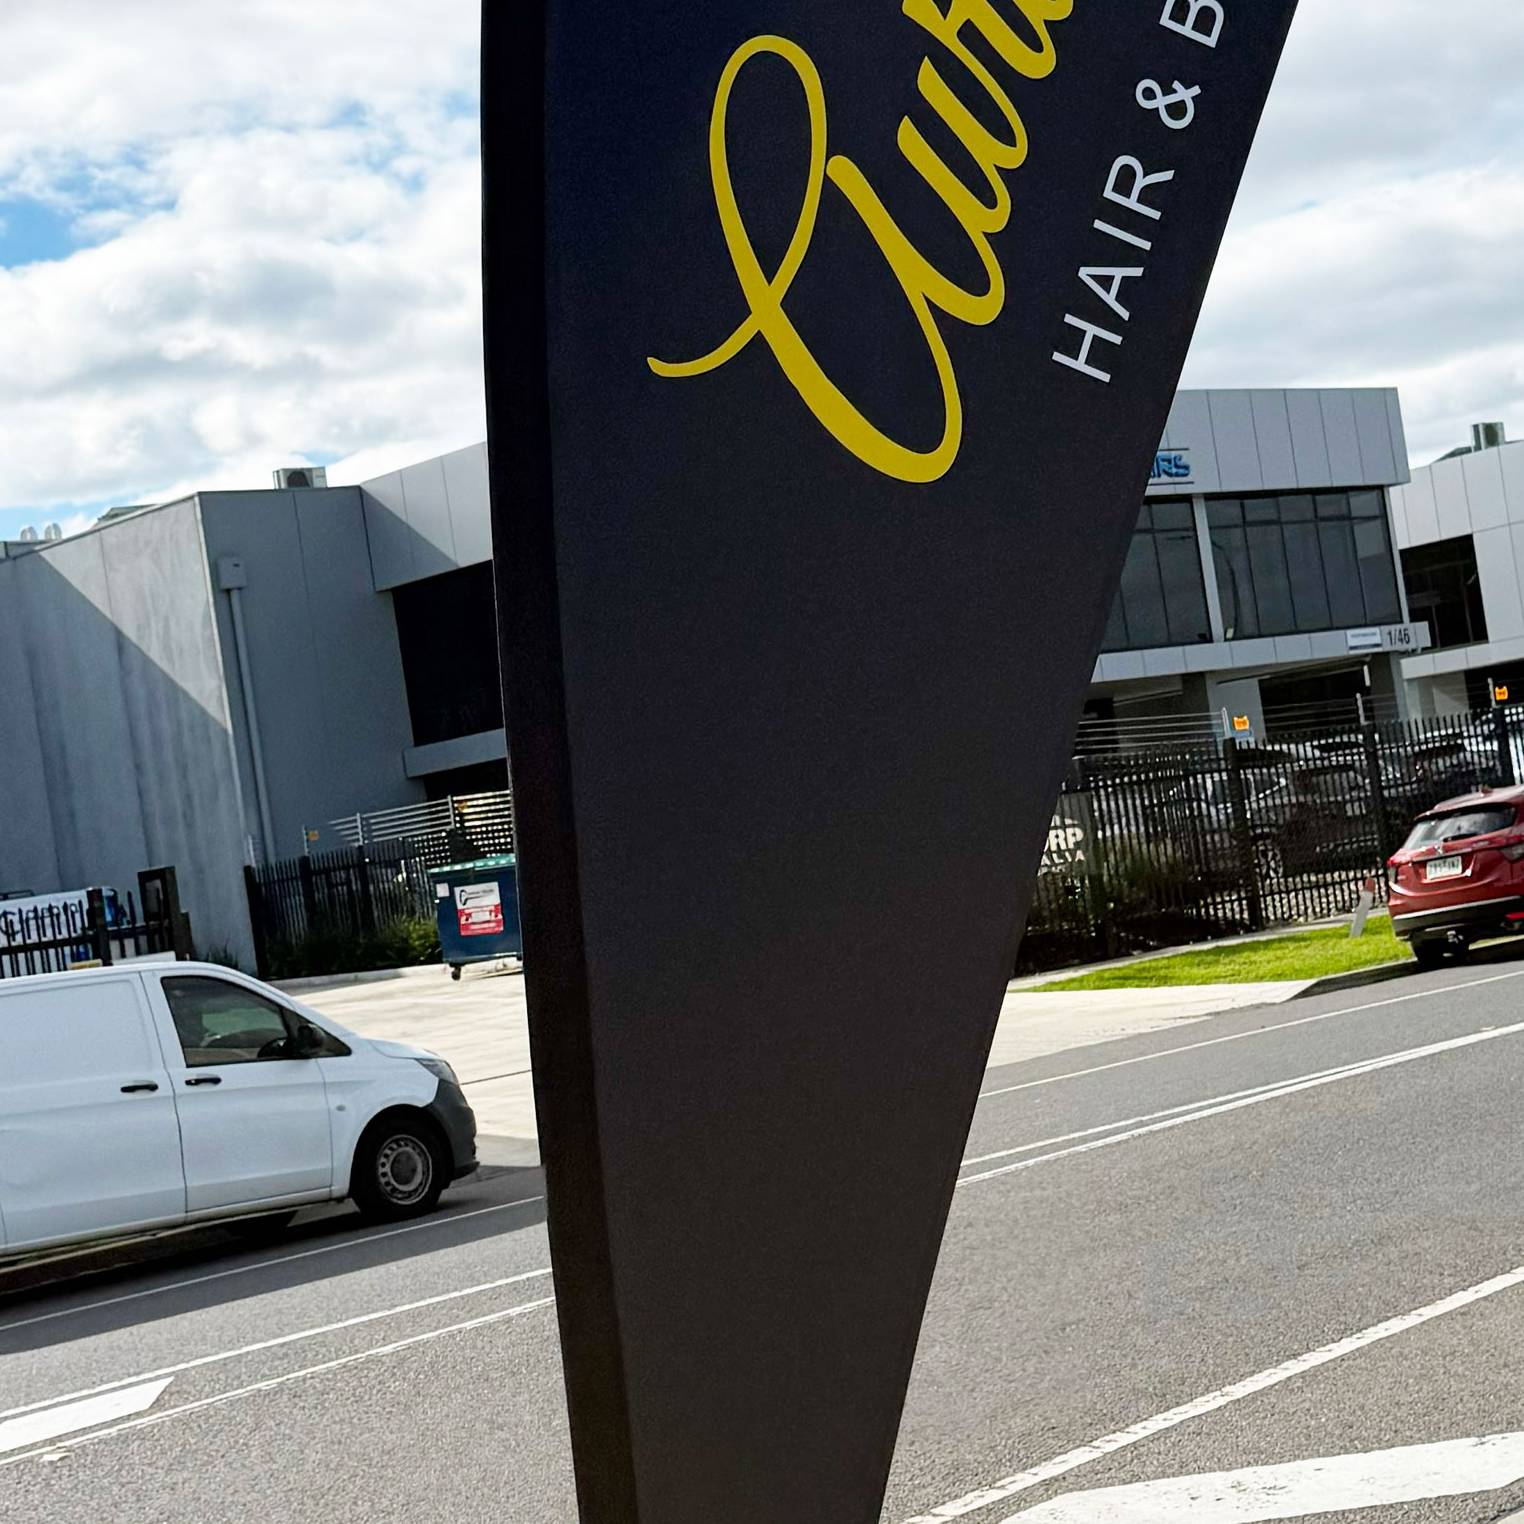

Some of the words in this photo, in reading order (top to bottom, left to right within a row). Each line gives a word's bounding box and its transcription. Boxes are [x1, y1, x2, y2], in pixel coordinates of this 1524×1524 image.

[1051, 153, 1175, 383] HAIR
[1135, 78, 1202, 130] &
[1387, 628, 1411, 646] 1/46
